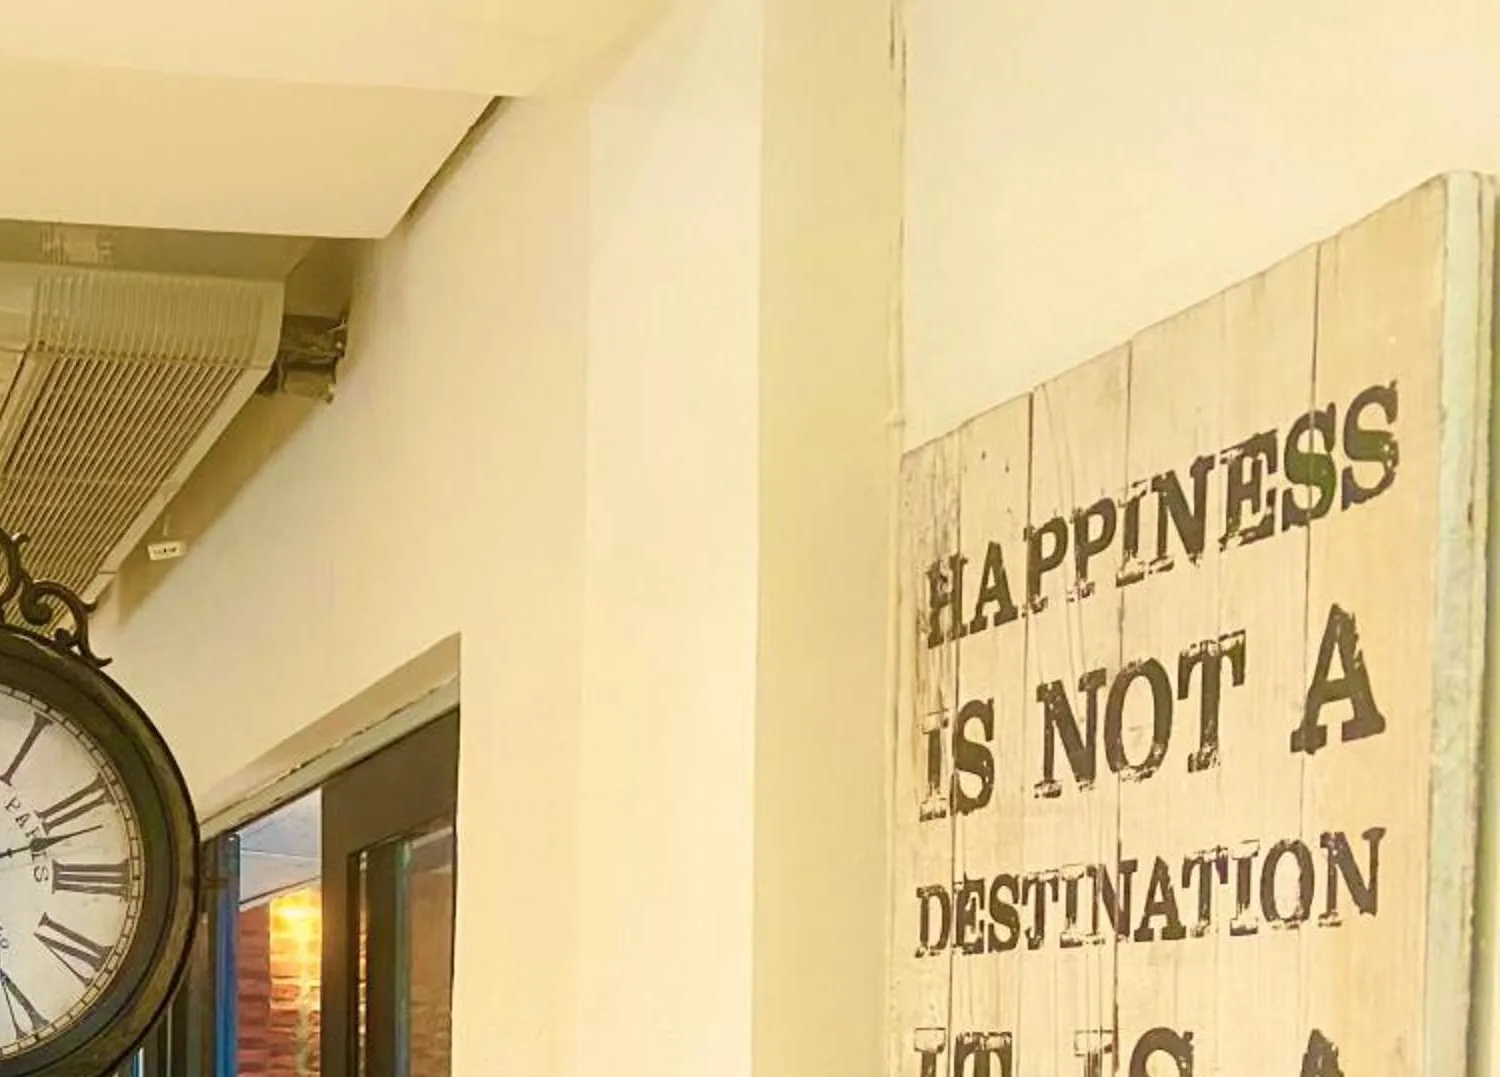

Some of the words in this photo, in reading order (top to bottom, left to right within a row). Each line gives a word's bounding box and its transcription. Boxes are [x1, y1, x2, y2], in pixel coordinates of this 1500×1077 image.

[921, 379, 1400, 650] HAPPINESS
[916, 697, 996, 823] IS
[1033, 629, 1247, 799] NOT
[1289, 603, 1387, 755] A
[51, 859, 130, 896] III
[914, 827, 1387, 959] DESTINATION
